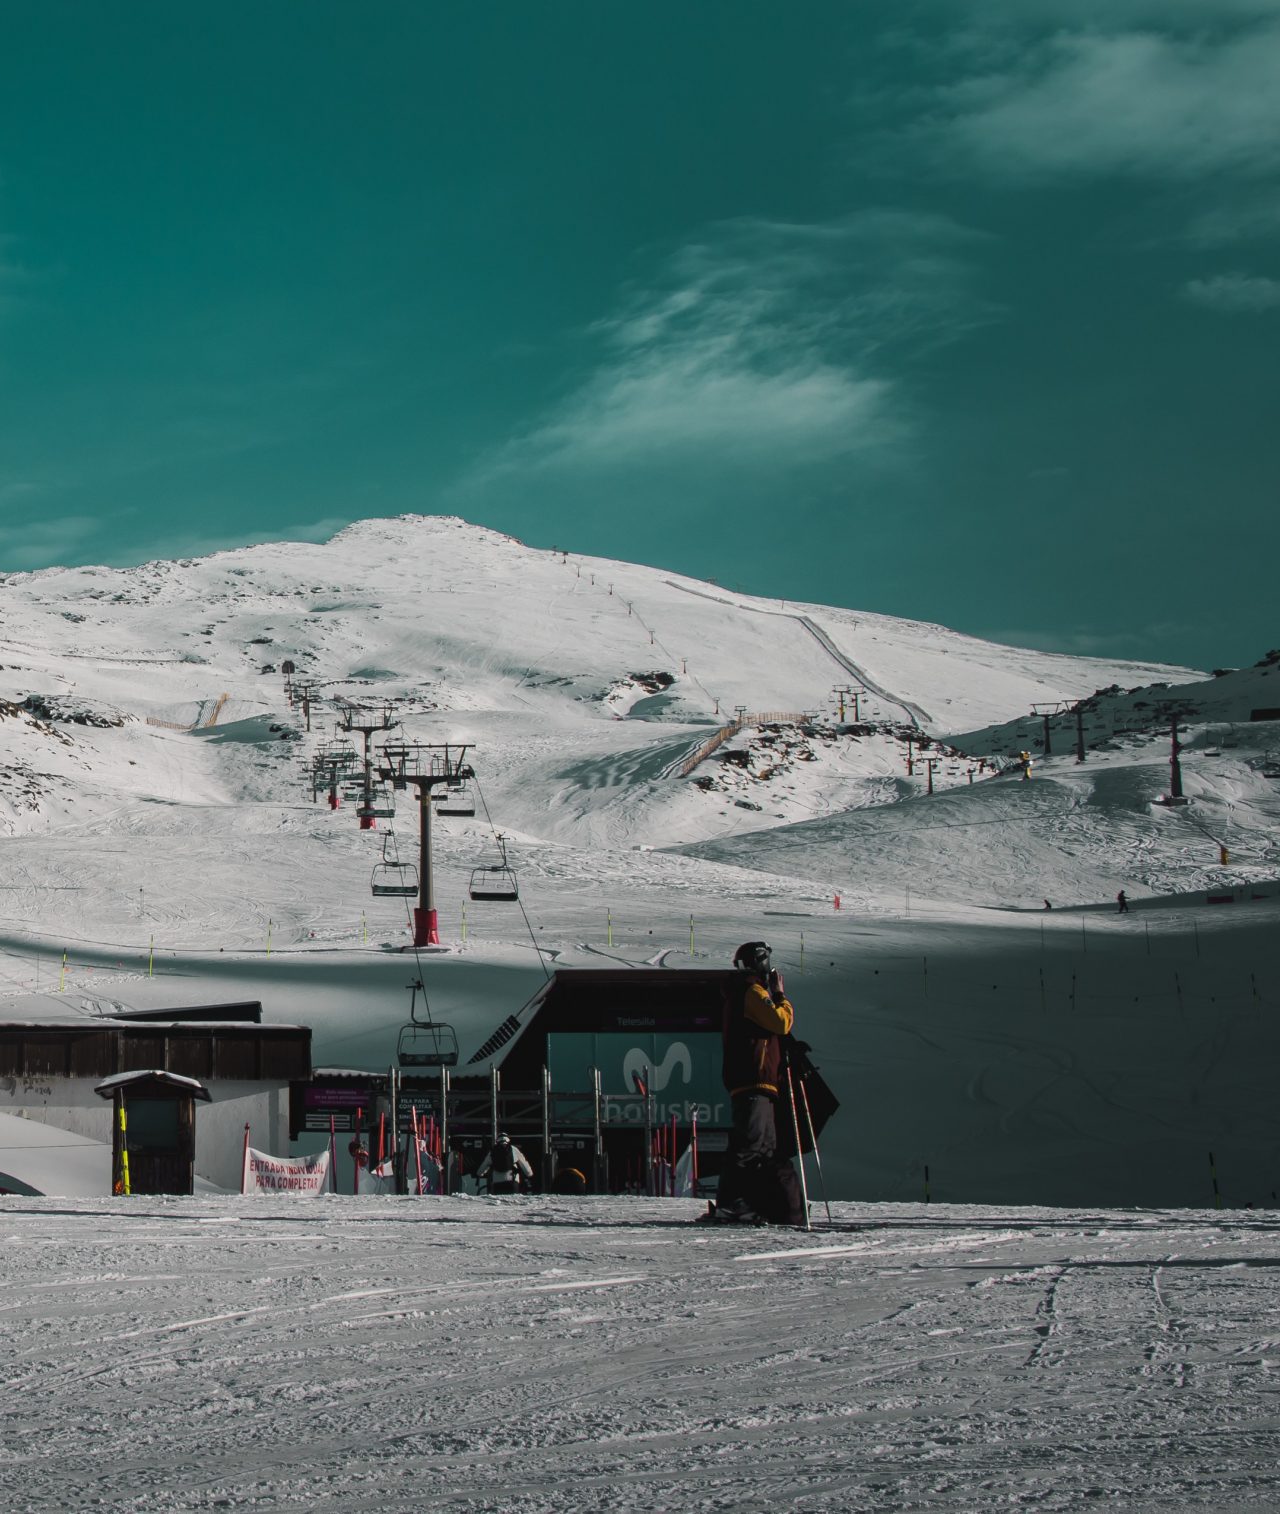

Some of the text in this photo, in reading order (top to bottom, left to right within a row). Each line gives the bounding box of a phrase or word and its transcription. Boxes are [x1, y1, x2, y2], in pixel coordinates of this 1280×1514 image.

[250, 1159, 285, 1174] ENTRADA
[255, 1175, 318, 1190] PARA COMPLETAR
